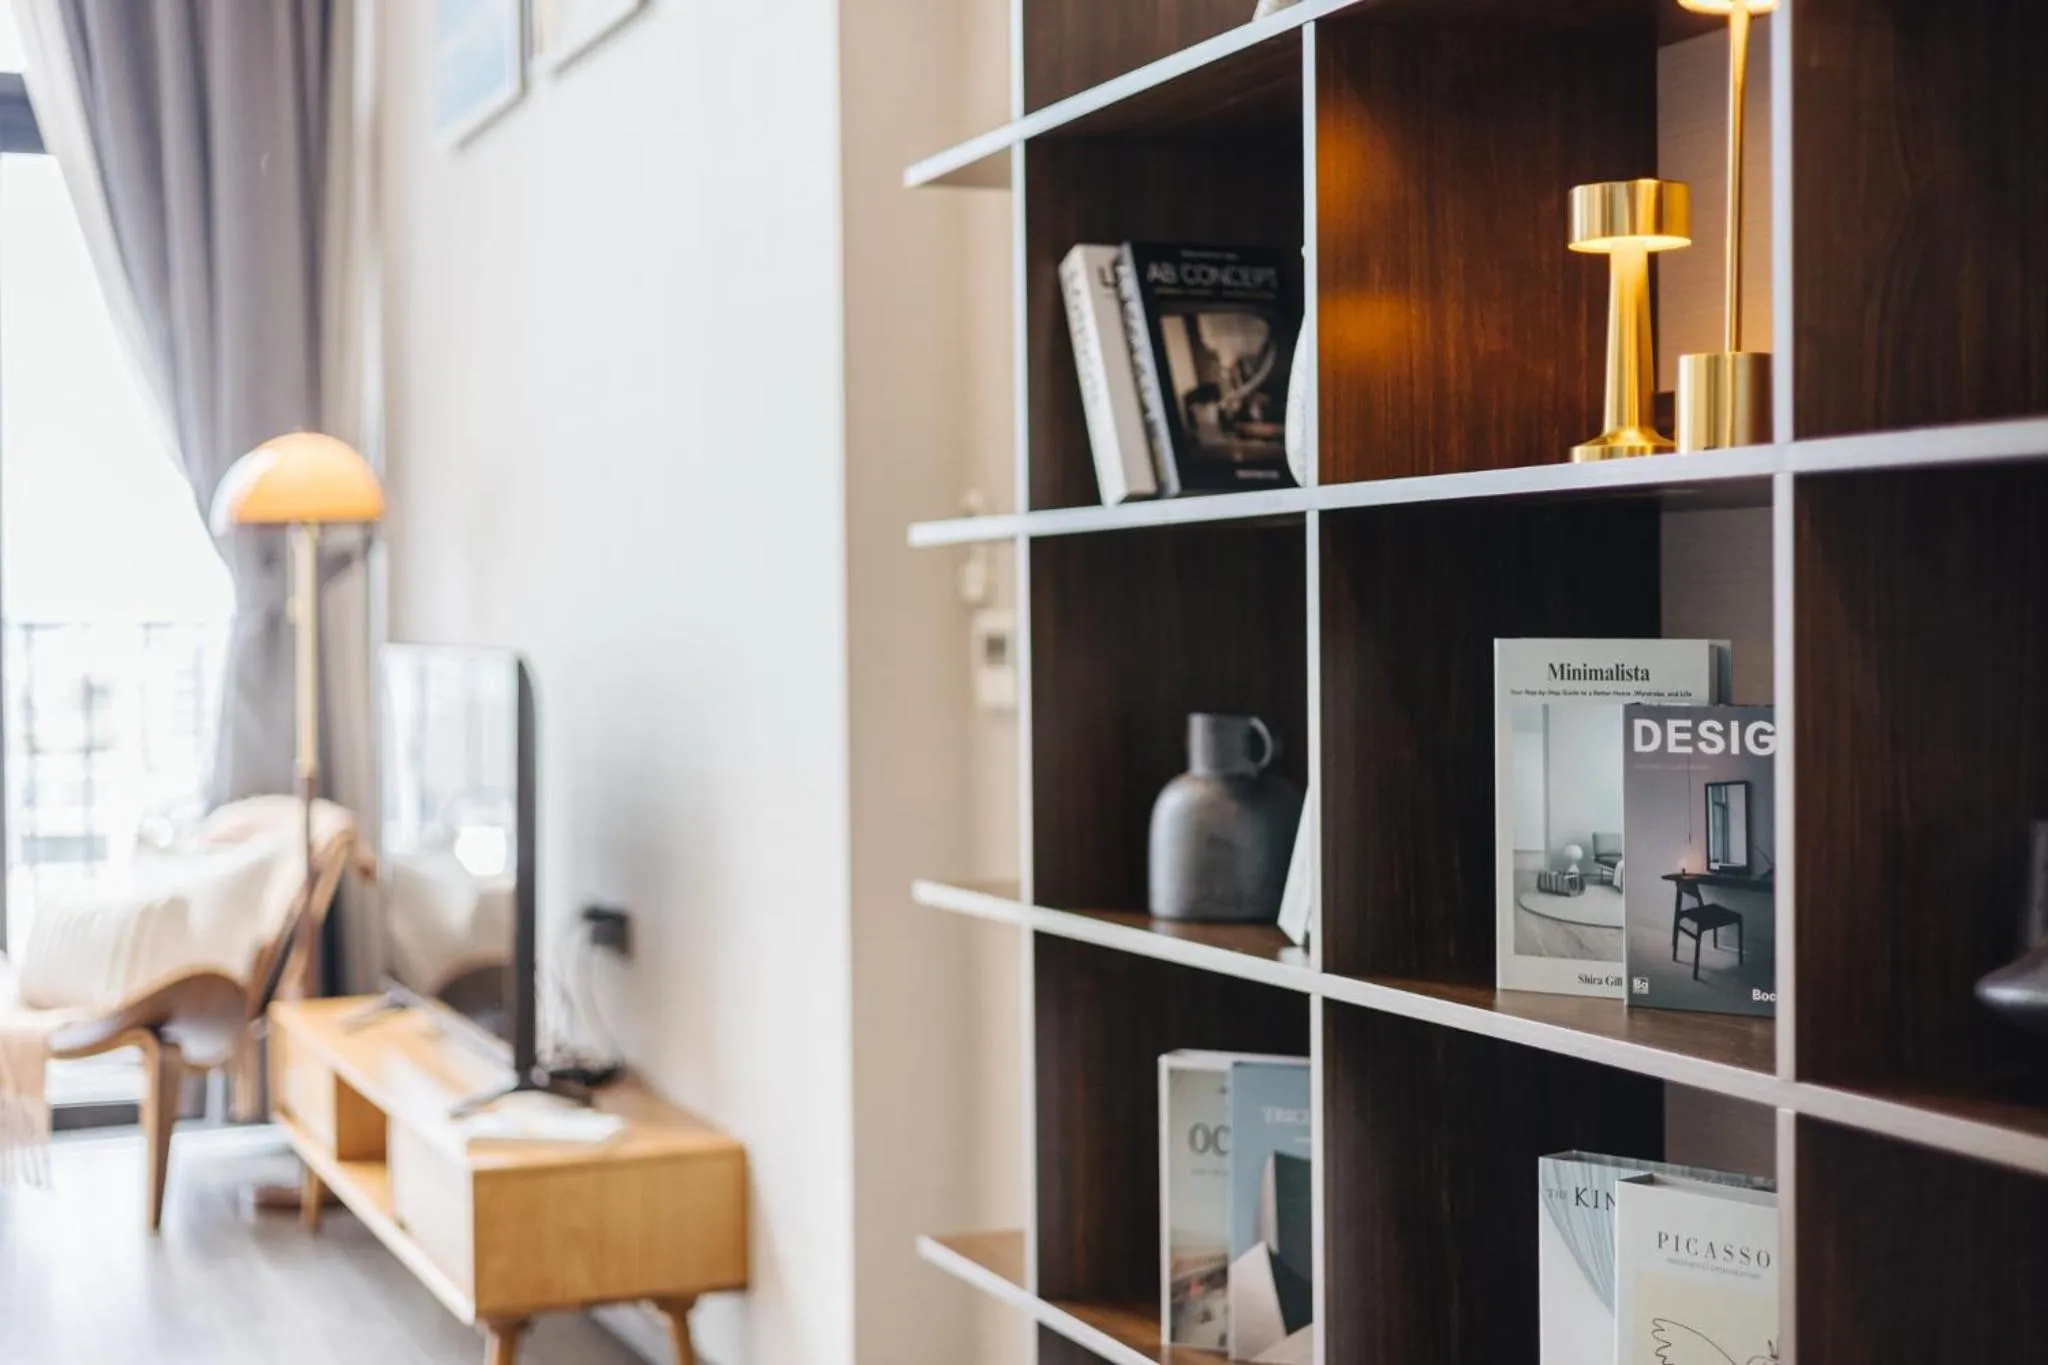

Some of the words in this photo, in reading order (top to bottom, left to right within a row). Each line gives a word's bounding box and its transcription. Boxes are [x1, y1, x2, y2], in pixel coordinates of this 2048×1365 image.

[1548, 662, 1651, 681] Minimalista
[1633, 718, 1776, 756] DESIG
[1577, 973, 1603, 985] Shira
[1657, 1230, 1771, 1269] PICASSO
